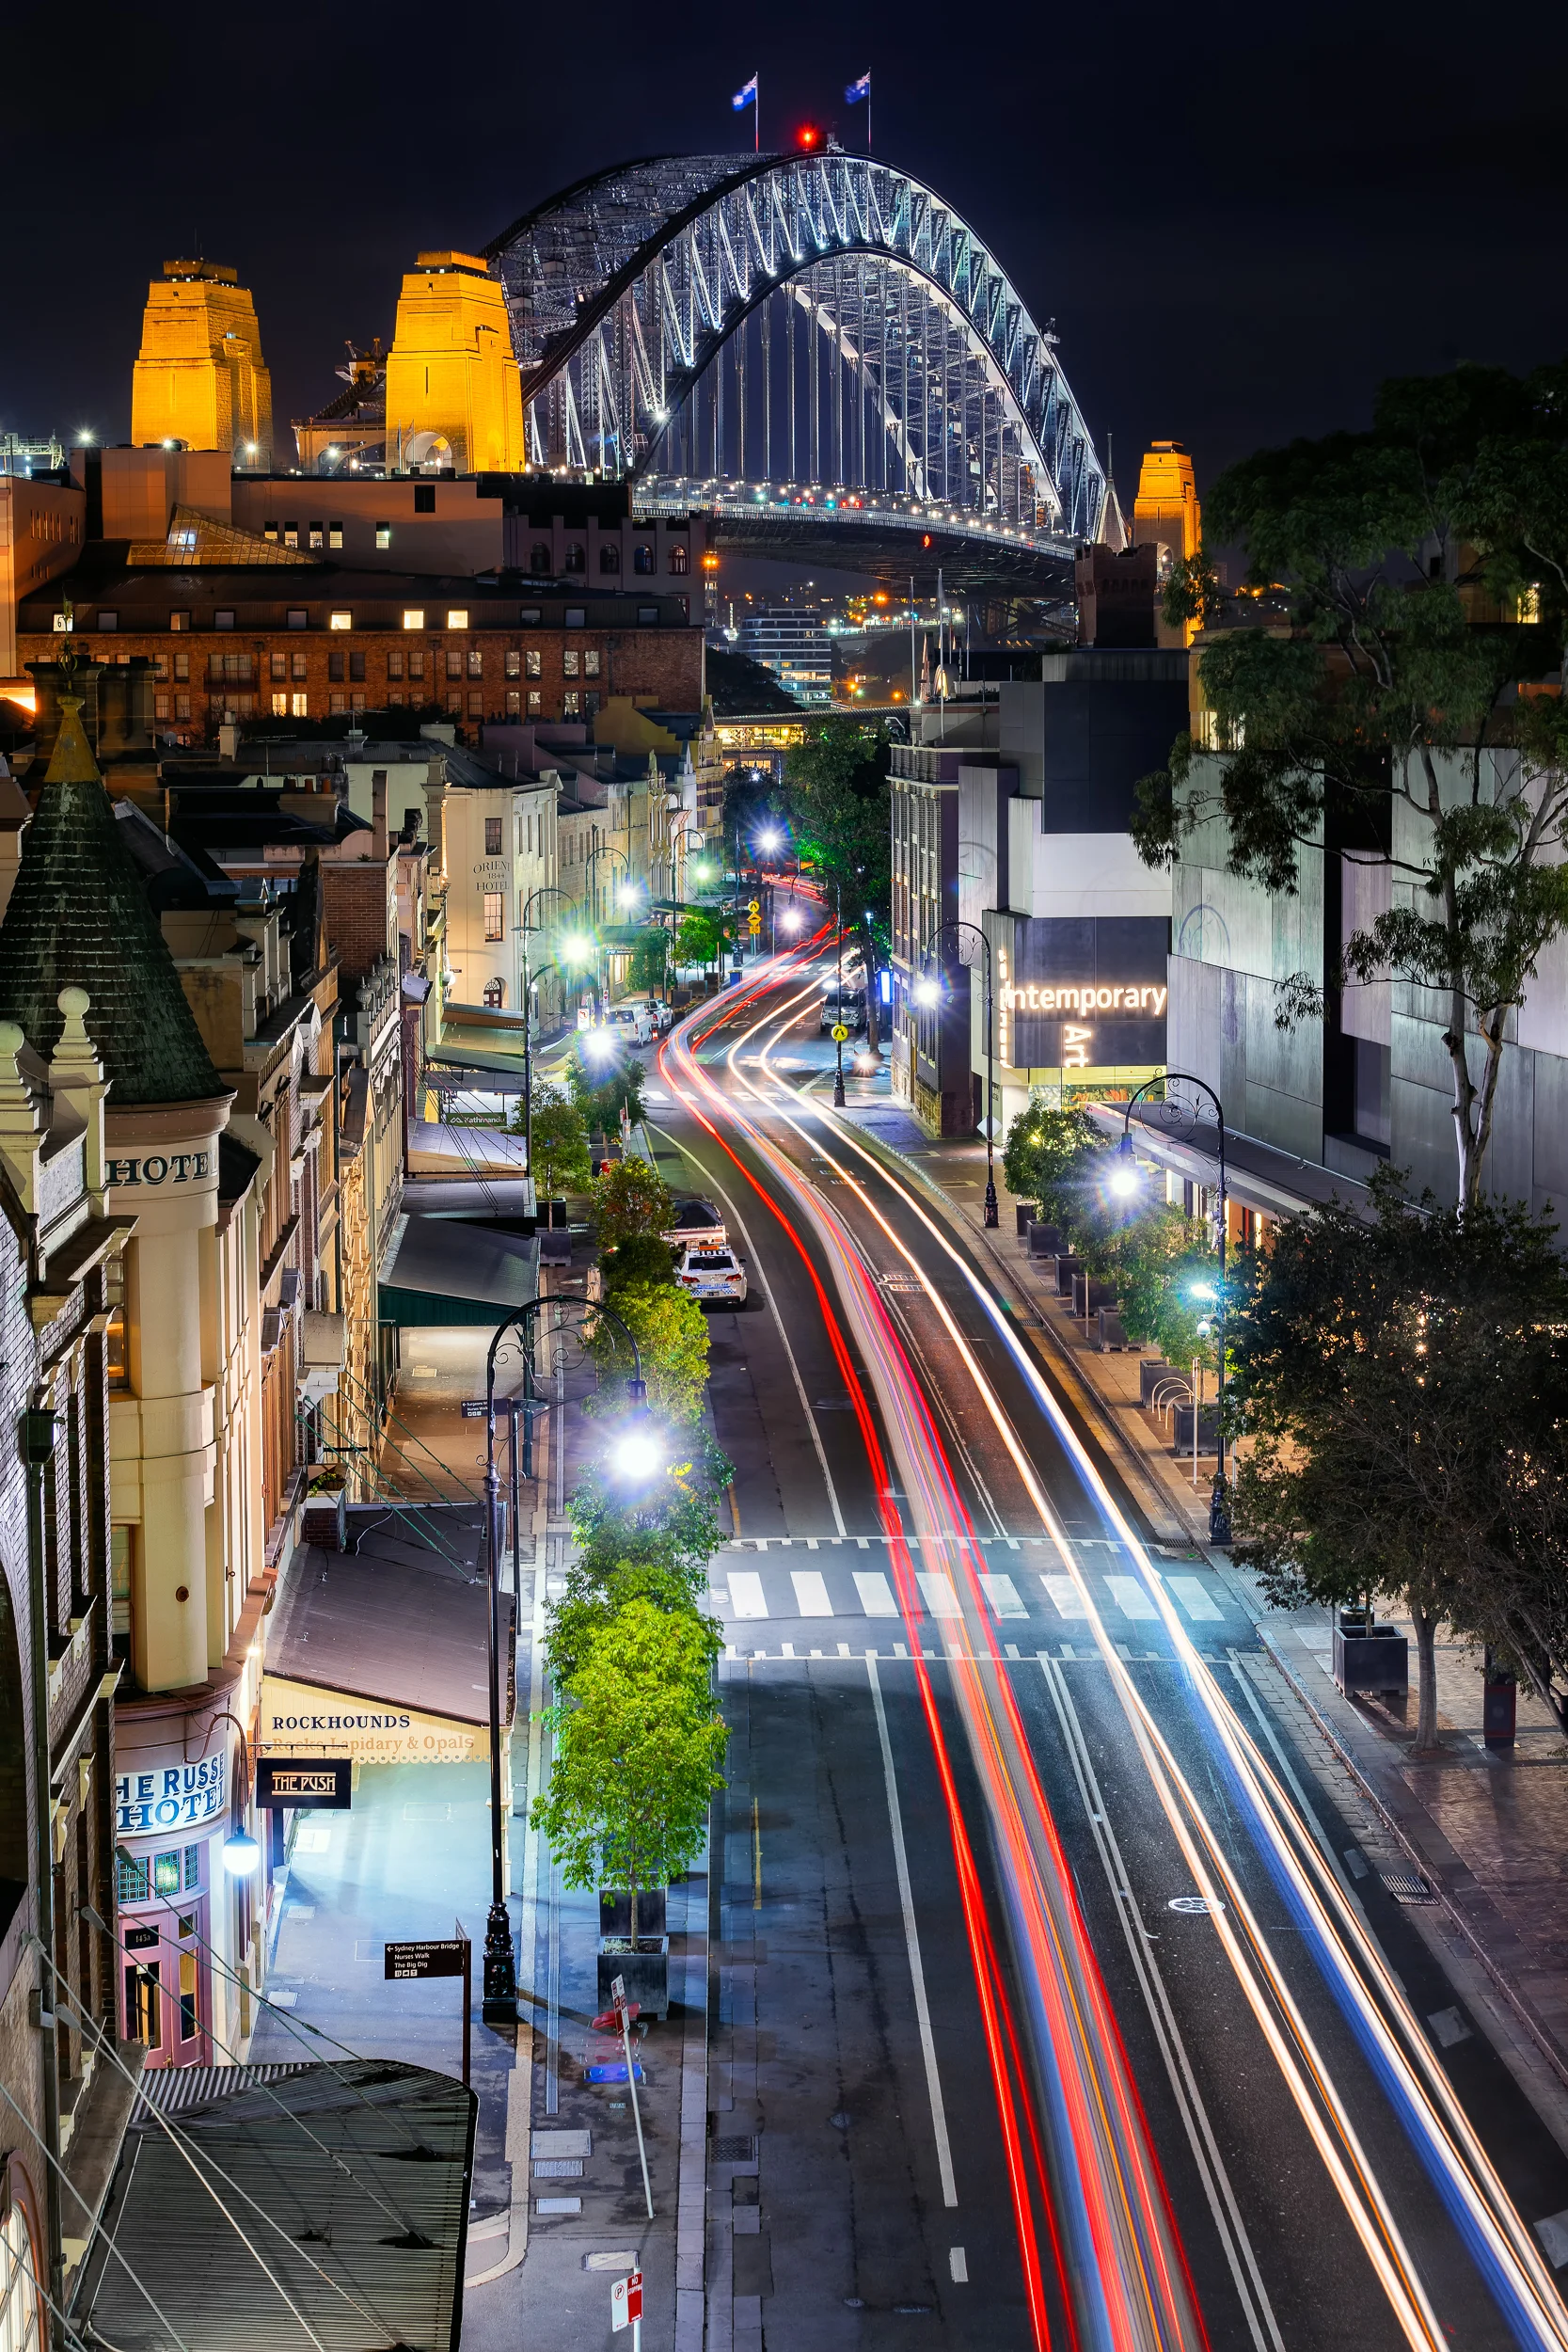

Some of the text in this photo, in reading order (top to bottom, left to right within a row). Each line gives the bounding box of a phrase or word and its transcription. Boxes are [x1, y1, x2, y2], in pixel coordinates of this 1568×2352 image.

[476, 882, 509, 891] HOTEL
[1064, 1025, 1092, 1069] Art
[104, 1151, 217, 1186] HOTEL
[272, 1715, 410, 1730] ROCKHOUNDS
[272, 1735, 474, 1755] Rocks Lapidary & Opals
[272, 1776, 336, 1791] THE PUSH
[117, 1780, 225, 1832] HOTEL
[394, 1945, 415, 1953] Sydney
[631, 2276, 639, 2286] NO
